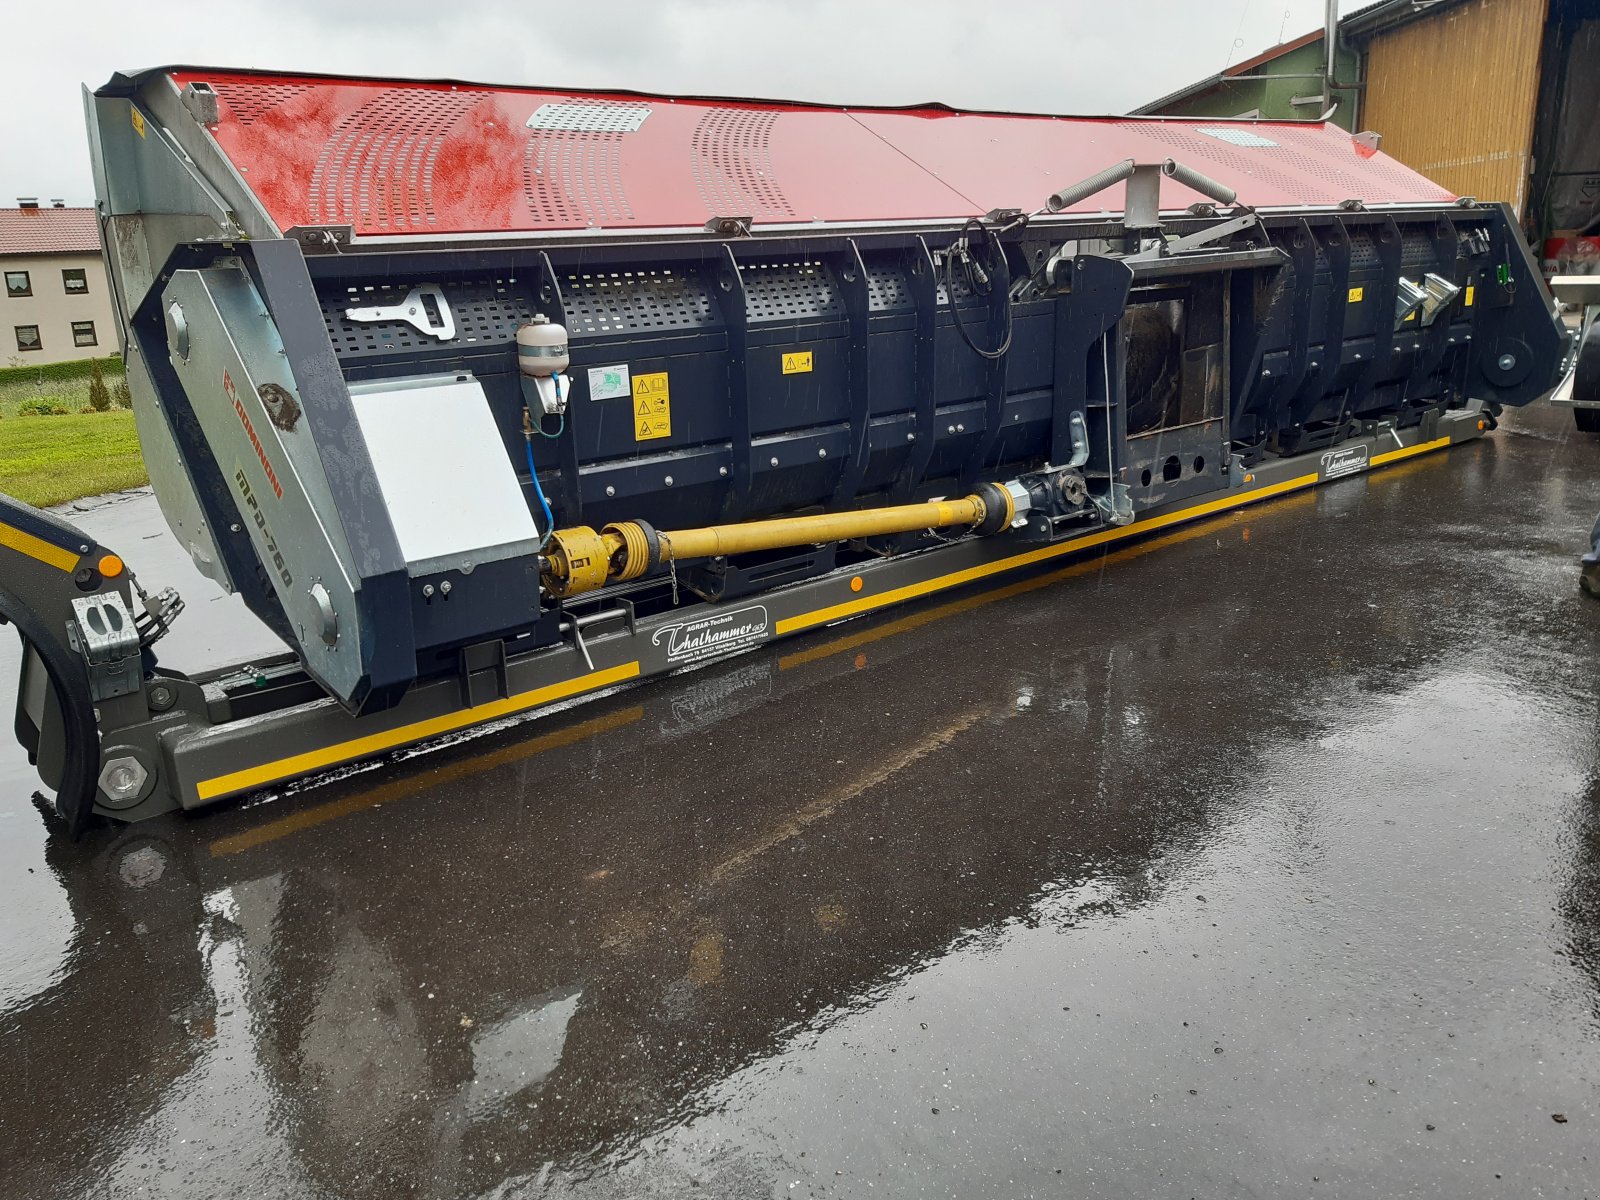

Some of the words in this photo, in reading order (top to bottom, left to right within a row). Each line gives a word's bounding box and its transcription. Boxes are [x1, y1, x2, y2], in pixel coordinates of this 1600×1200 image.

[234, 399, 283, 501] DOMINONI
[652, 623, 752, 656] Thalhammer
[687, 616, 733, 632] AGRAR-Technik
